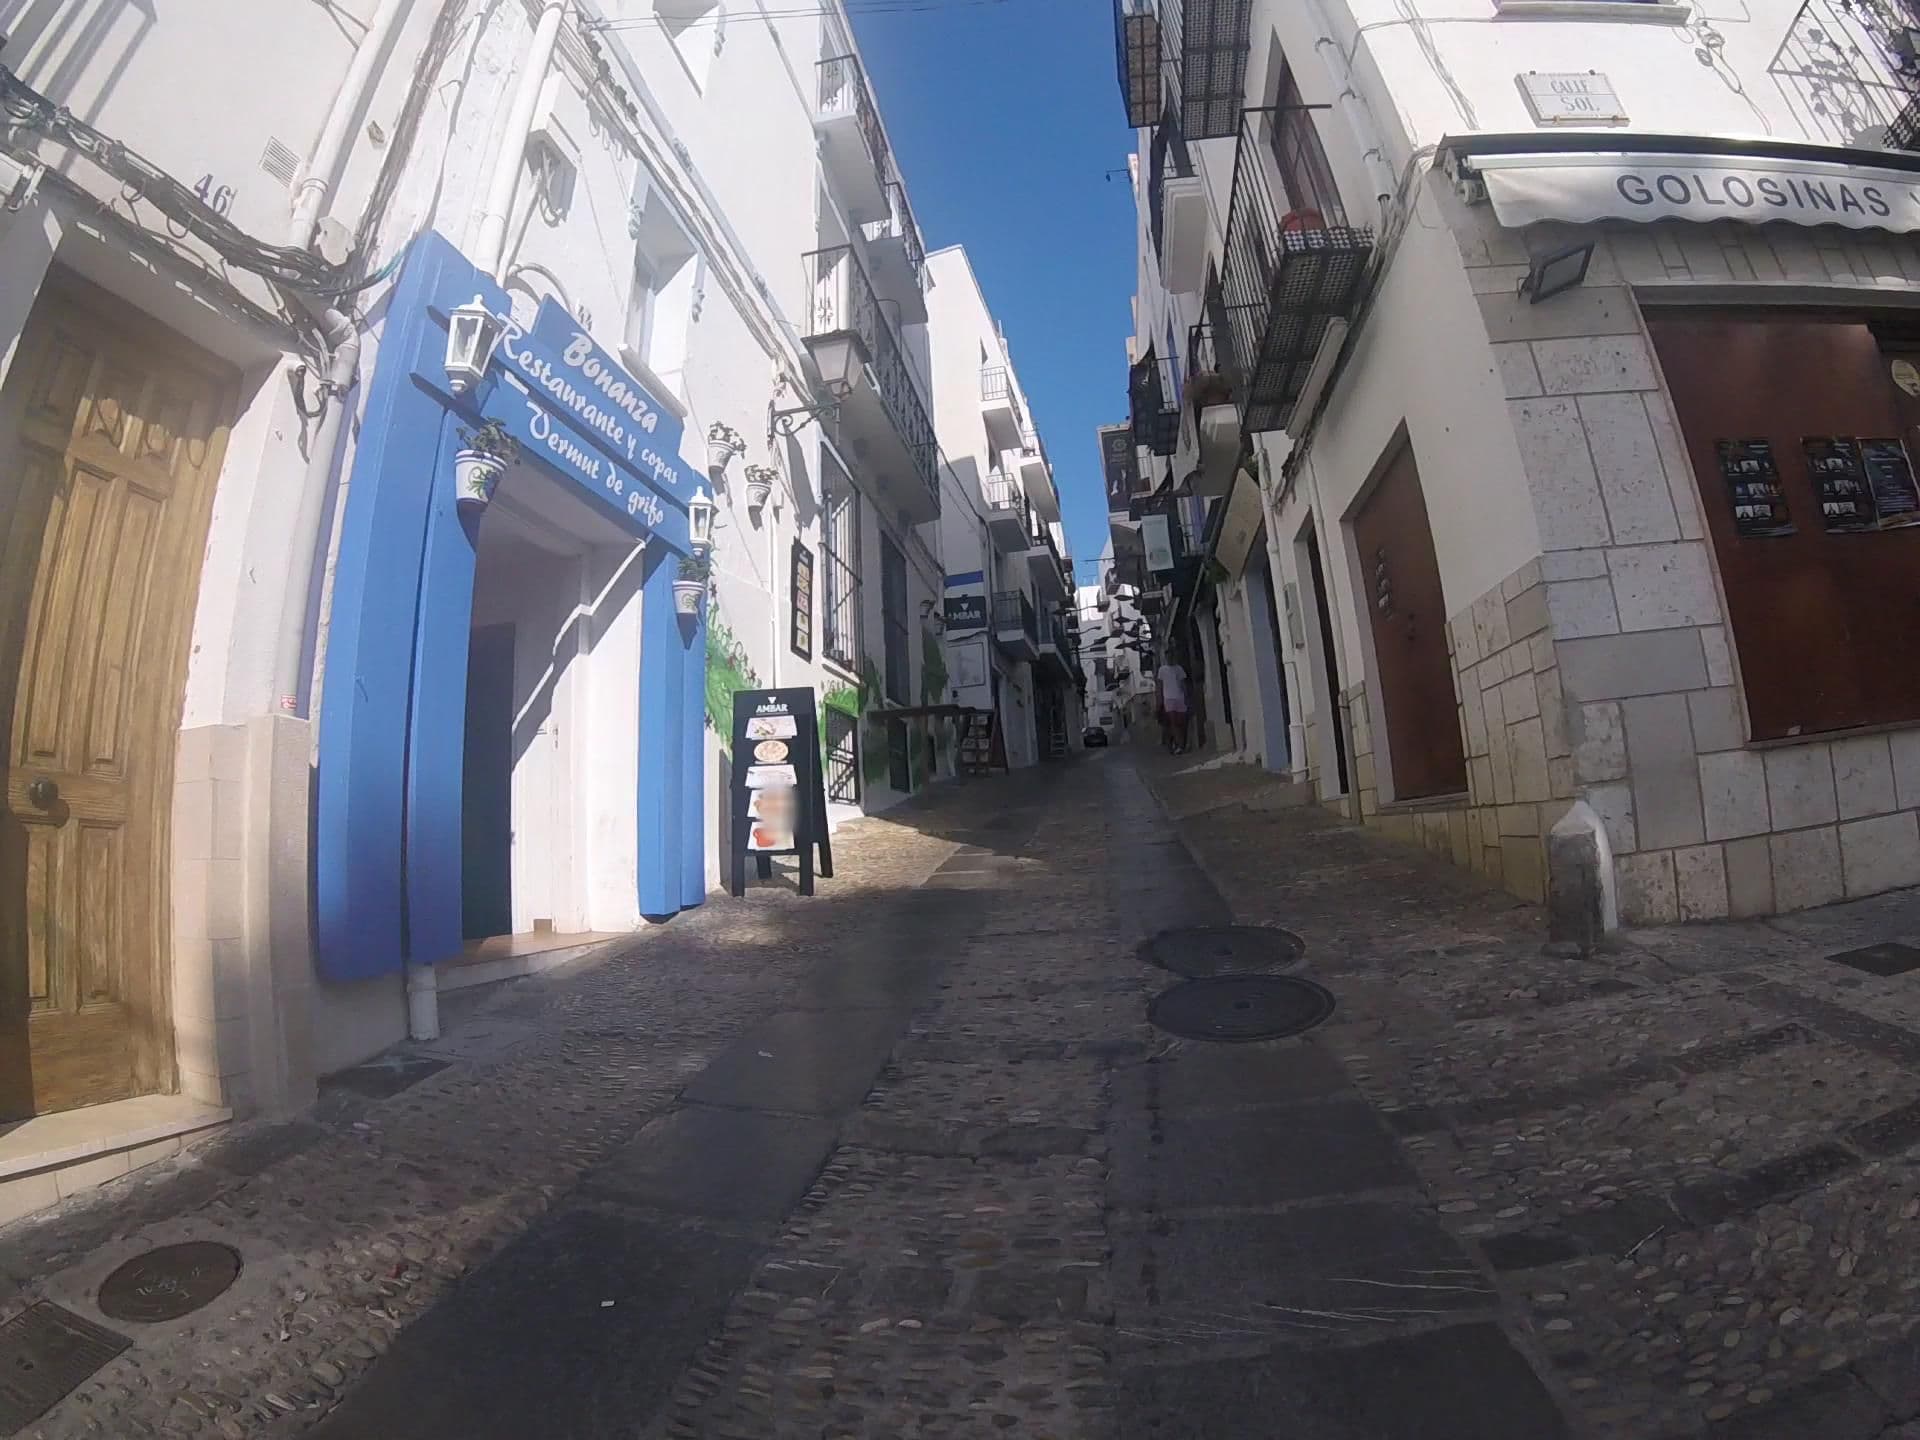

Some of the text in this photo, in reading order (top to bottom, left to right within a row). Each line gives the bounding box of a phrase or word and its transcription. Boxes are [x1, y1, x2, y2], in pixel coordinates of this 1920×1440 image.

[1550, 79, 1588, 94] CALLE
[1616, 174, 1890, 217] GOLOSINAS
[494, 312, 624, 445] Restaurante
[641, 449, 678, 485] copas
[563, 332, 658, 433] Bonanza
[526, 400, 664, 527] Vermut de grifo
[755, 703, 788, 714] AMBAR
